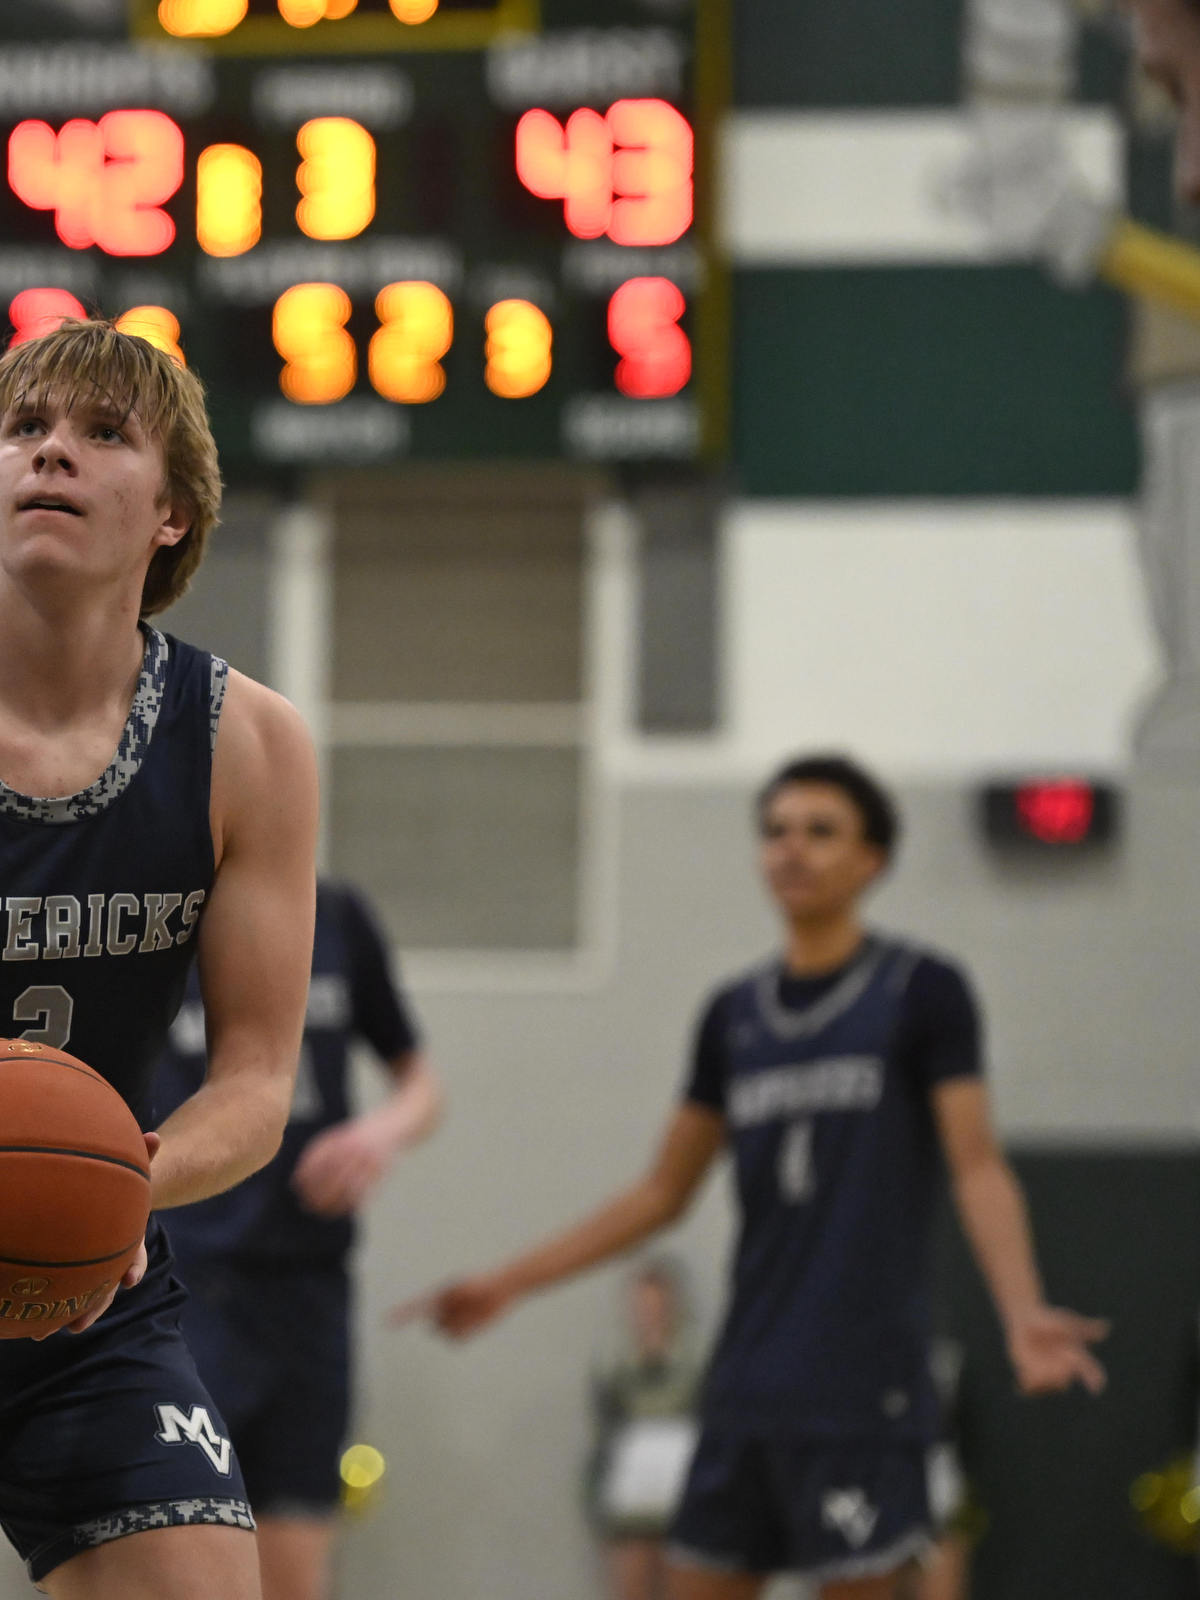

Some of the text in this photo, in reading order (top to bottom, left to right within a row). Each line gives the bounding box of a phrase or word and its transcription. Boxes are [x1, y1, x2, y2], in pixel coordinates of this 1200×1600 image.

[8, 109, 185, 256] 42
[516, 98, 694, 246] 43
[154, 1402, 233, 1479] MV
